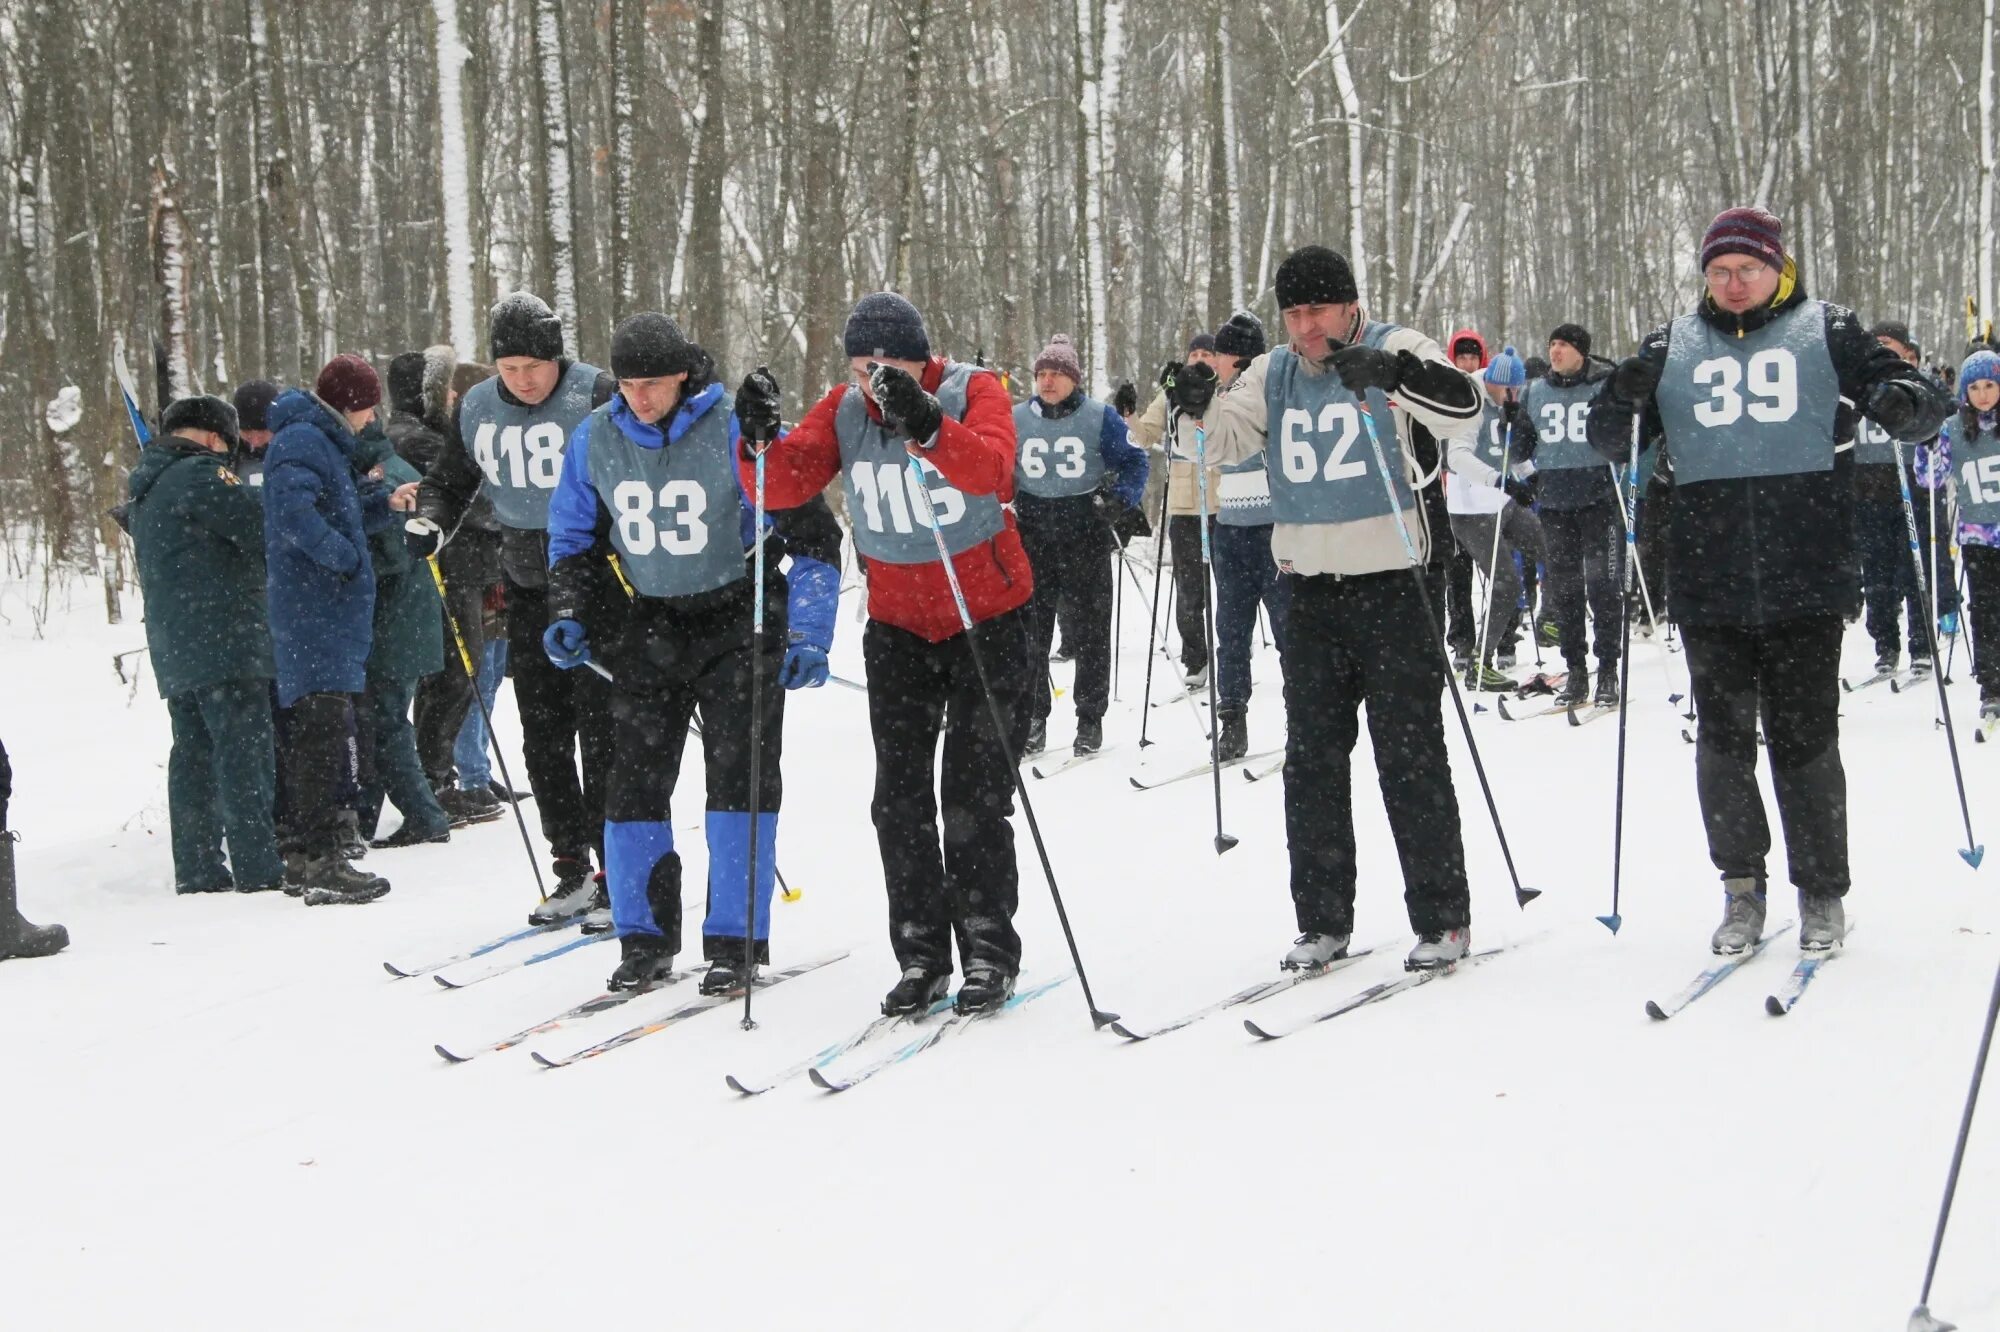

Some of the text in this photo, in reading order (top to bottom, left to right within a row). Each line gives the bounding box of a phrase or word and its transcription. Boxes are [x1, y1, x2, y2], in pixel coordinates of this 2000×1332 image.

[1540, 402, 1592, 443] 36
[1693, 348, 1798, 428] 39
[473, 422, 564, 489] 418
[1021, 436, 1086, 478] 63
[1281, 403, 1366, 483] 62
[851, 457, 966, 533] 116
[1961, 455, 2000, 504] 15
[614, 480, 708, 555] 83
